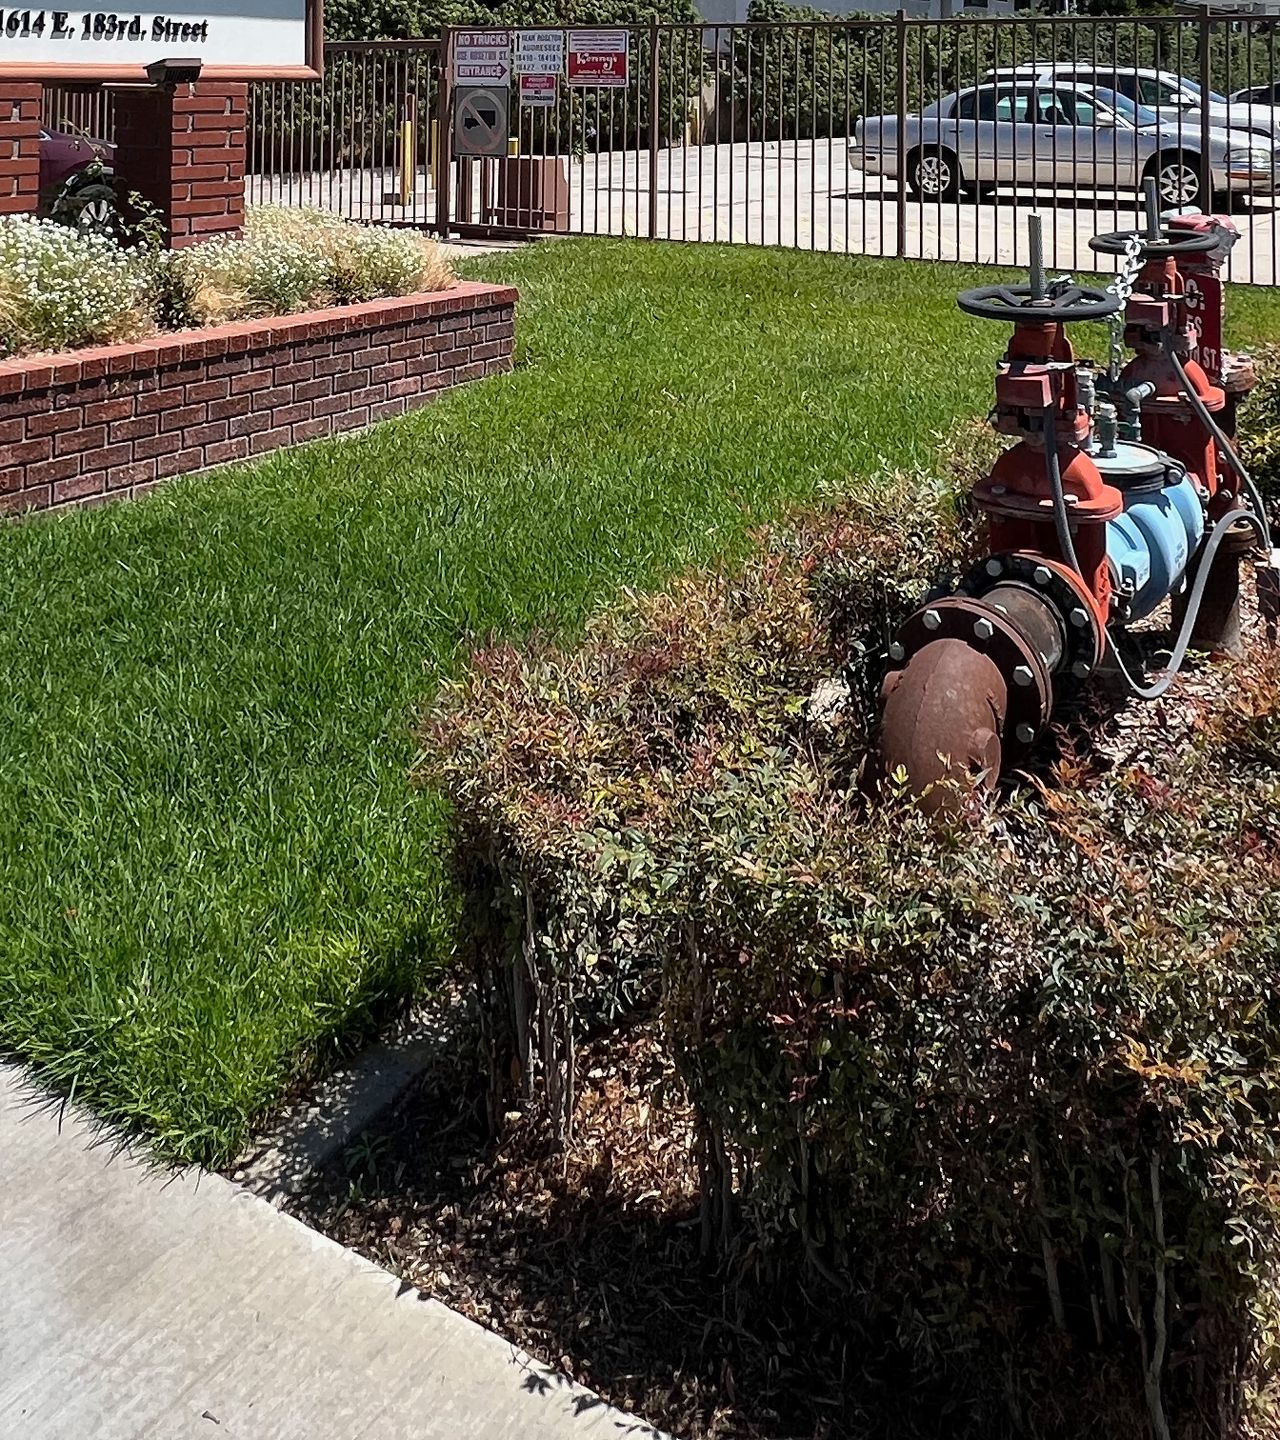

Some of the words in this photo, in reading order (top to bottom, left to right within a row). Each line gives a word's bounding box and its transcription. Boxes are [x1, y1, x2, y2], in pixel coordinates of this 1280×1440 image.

[51, 10, 76, 35] E.
[81, 12, 148, 37] 183rd.
[151, 14, 209, 38] Street
[457, 34, 471, 46] NO
[472, 34, 508, 46] TRUCKS
[522, 44, 561, 52] ADDRESSES
[576, 52, 618, 71] Kenny's
[459, 65, 502, 77] ENTRANCE
[1202, 346, 1219, 371] ST.
